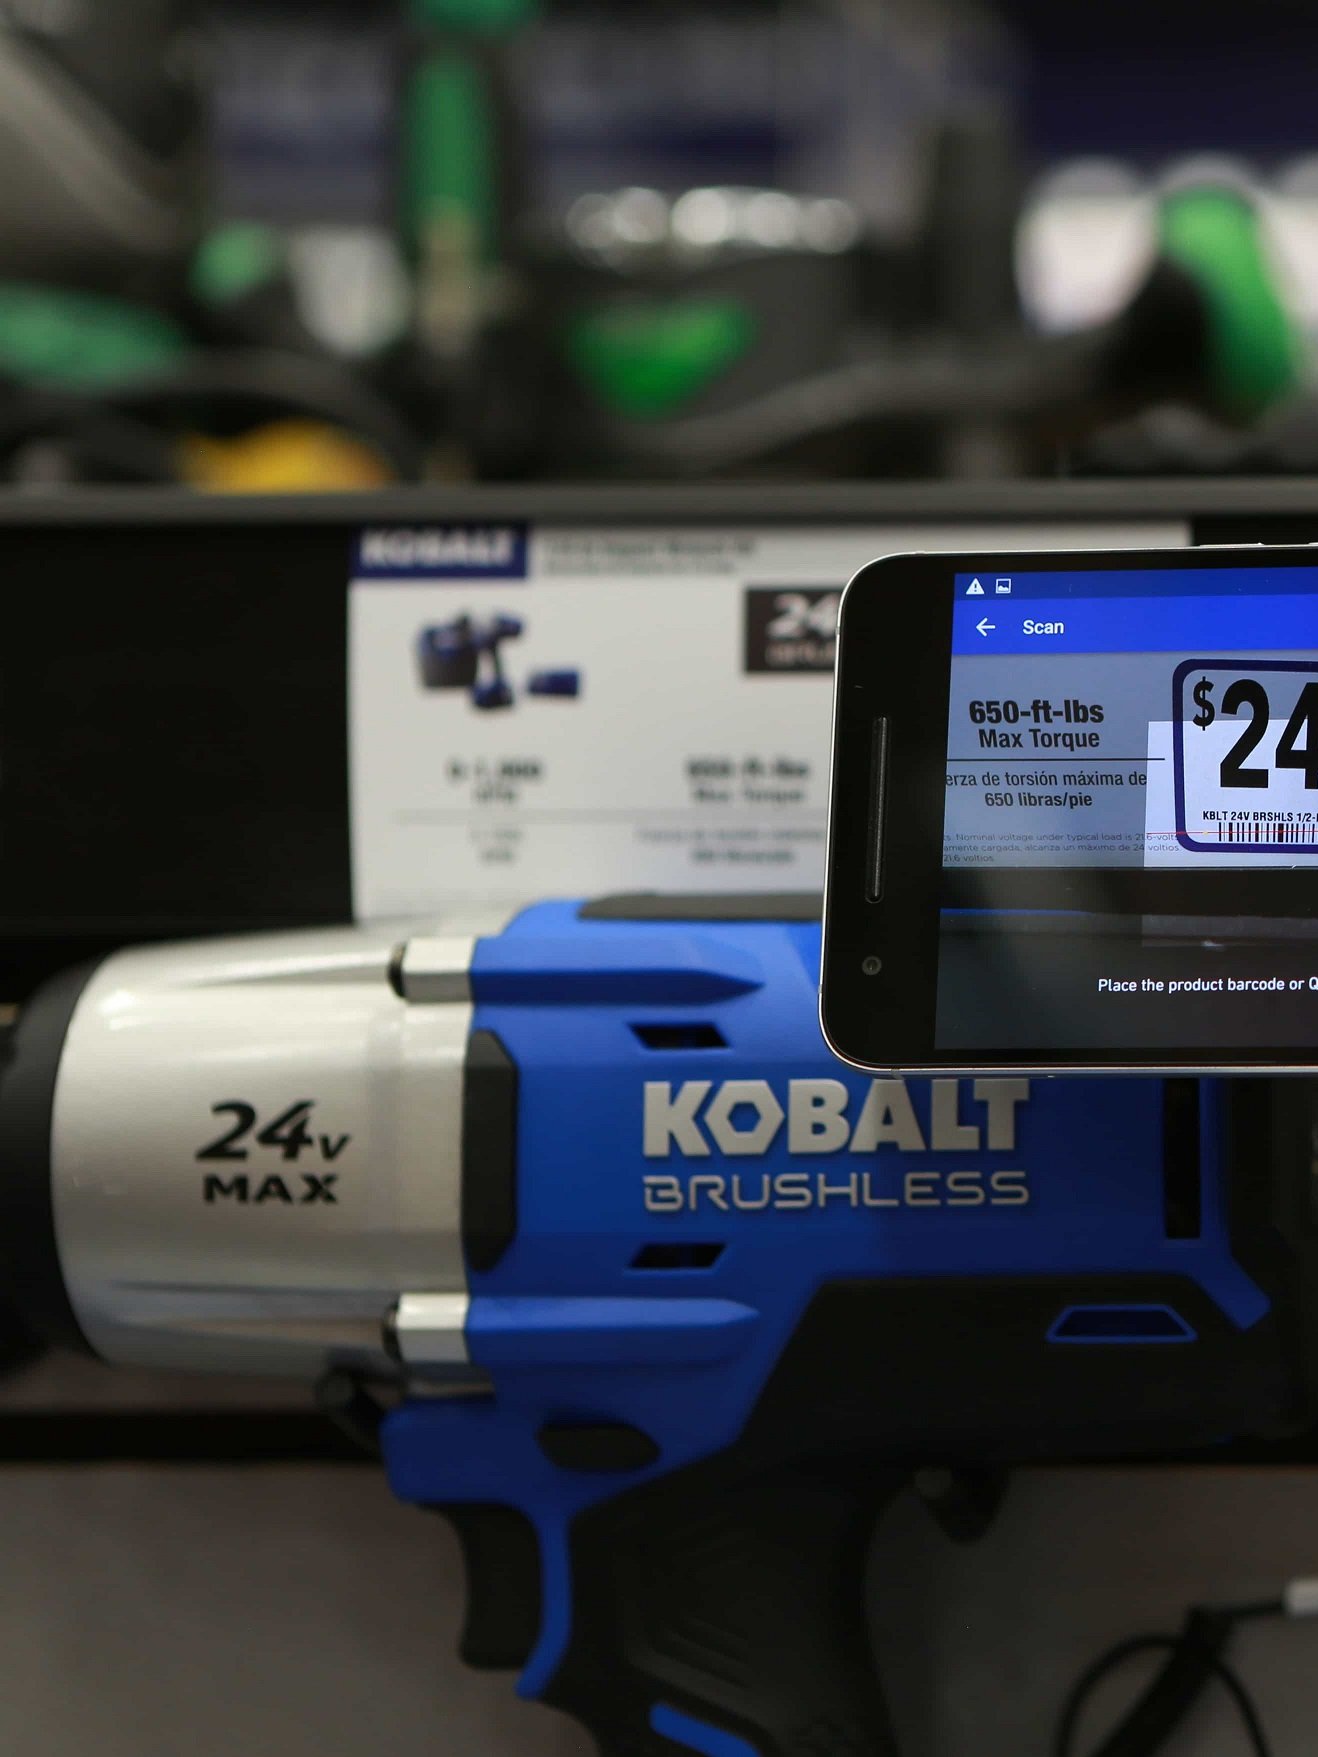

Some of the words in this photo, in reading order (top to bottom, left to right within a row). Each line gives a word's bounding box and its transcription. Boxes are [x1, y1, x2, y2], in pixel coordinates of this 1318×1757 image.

[1022, 619, 1065, 635] Scan
[969, 700, 1105, 724] 650-ft-lbs
[978, 729, 1023, 748] Max
[1029, 728, 1101, 751] Torque
[982, 771, 1000, 786] de
[1005, 770, 1057, 786] torsión
[1063, 770, 1123, 786] máxima
[1128, 771, 1147, 785] de
[984, 793, 1013, 806] 650
[1018, 792, 1093, 809] libras/pie
[1202, 811, 1228, 821] KBLT
[1230, 811, 1250, 821] 24V
[1252, 812, 1293, 822] BRSHLS
[999, 833, 1034, 843] voltage
[1036, 833, 1063, 841] under
[1066, 833, 1098, 843] typical
[1101, 833, 1122, 841] load
[1098, 979, 1138, 992] Place
[1141, 979, 1164, 992] the
[1168, 978, 1223, 994] product
[1227, 978, 1285, 991] barcode
[1289, 979, 1305, 990] or
[643, 1078, 1030, 1157] KOBALT
[203, 1174, 339, 1204] MAX
[642, 1171, 1030, 1211] BRUSHLESS
